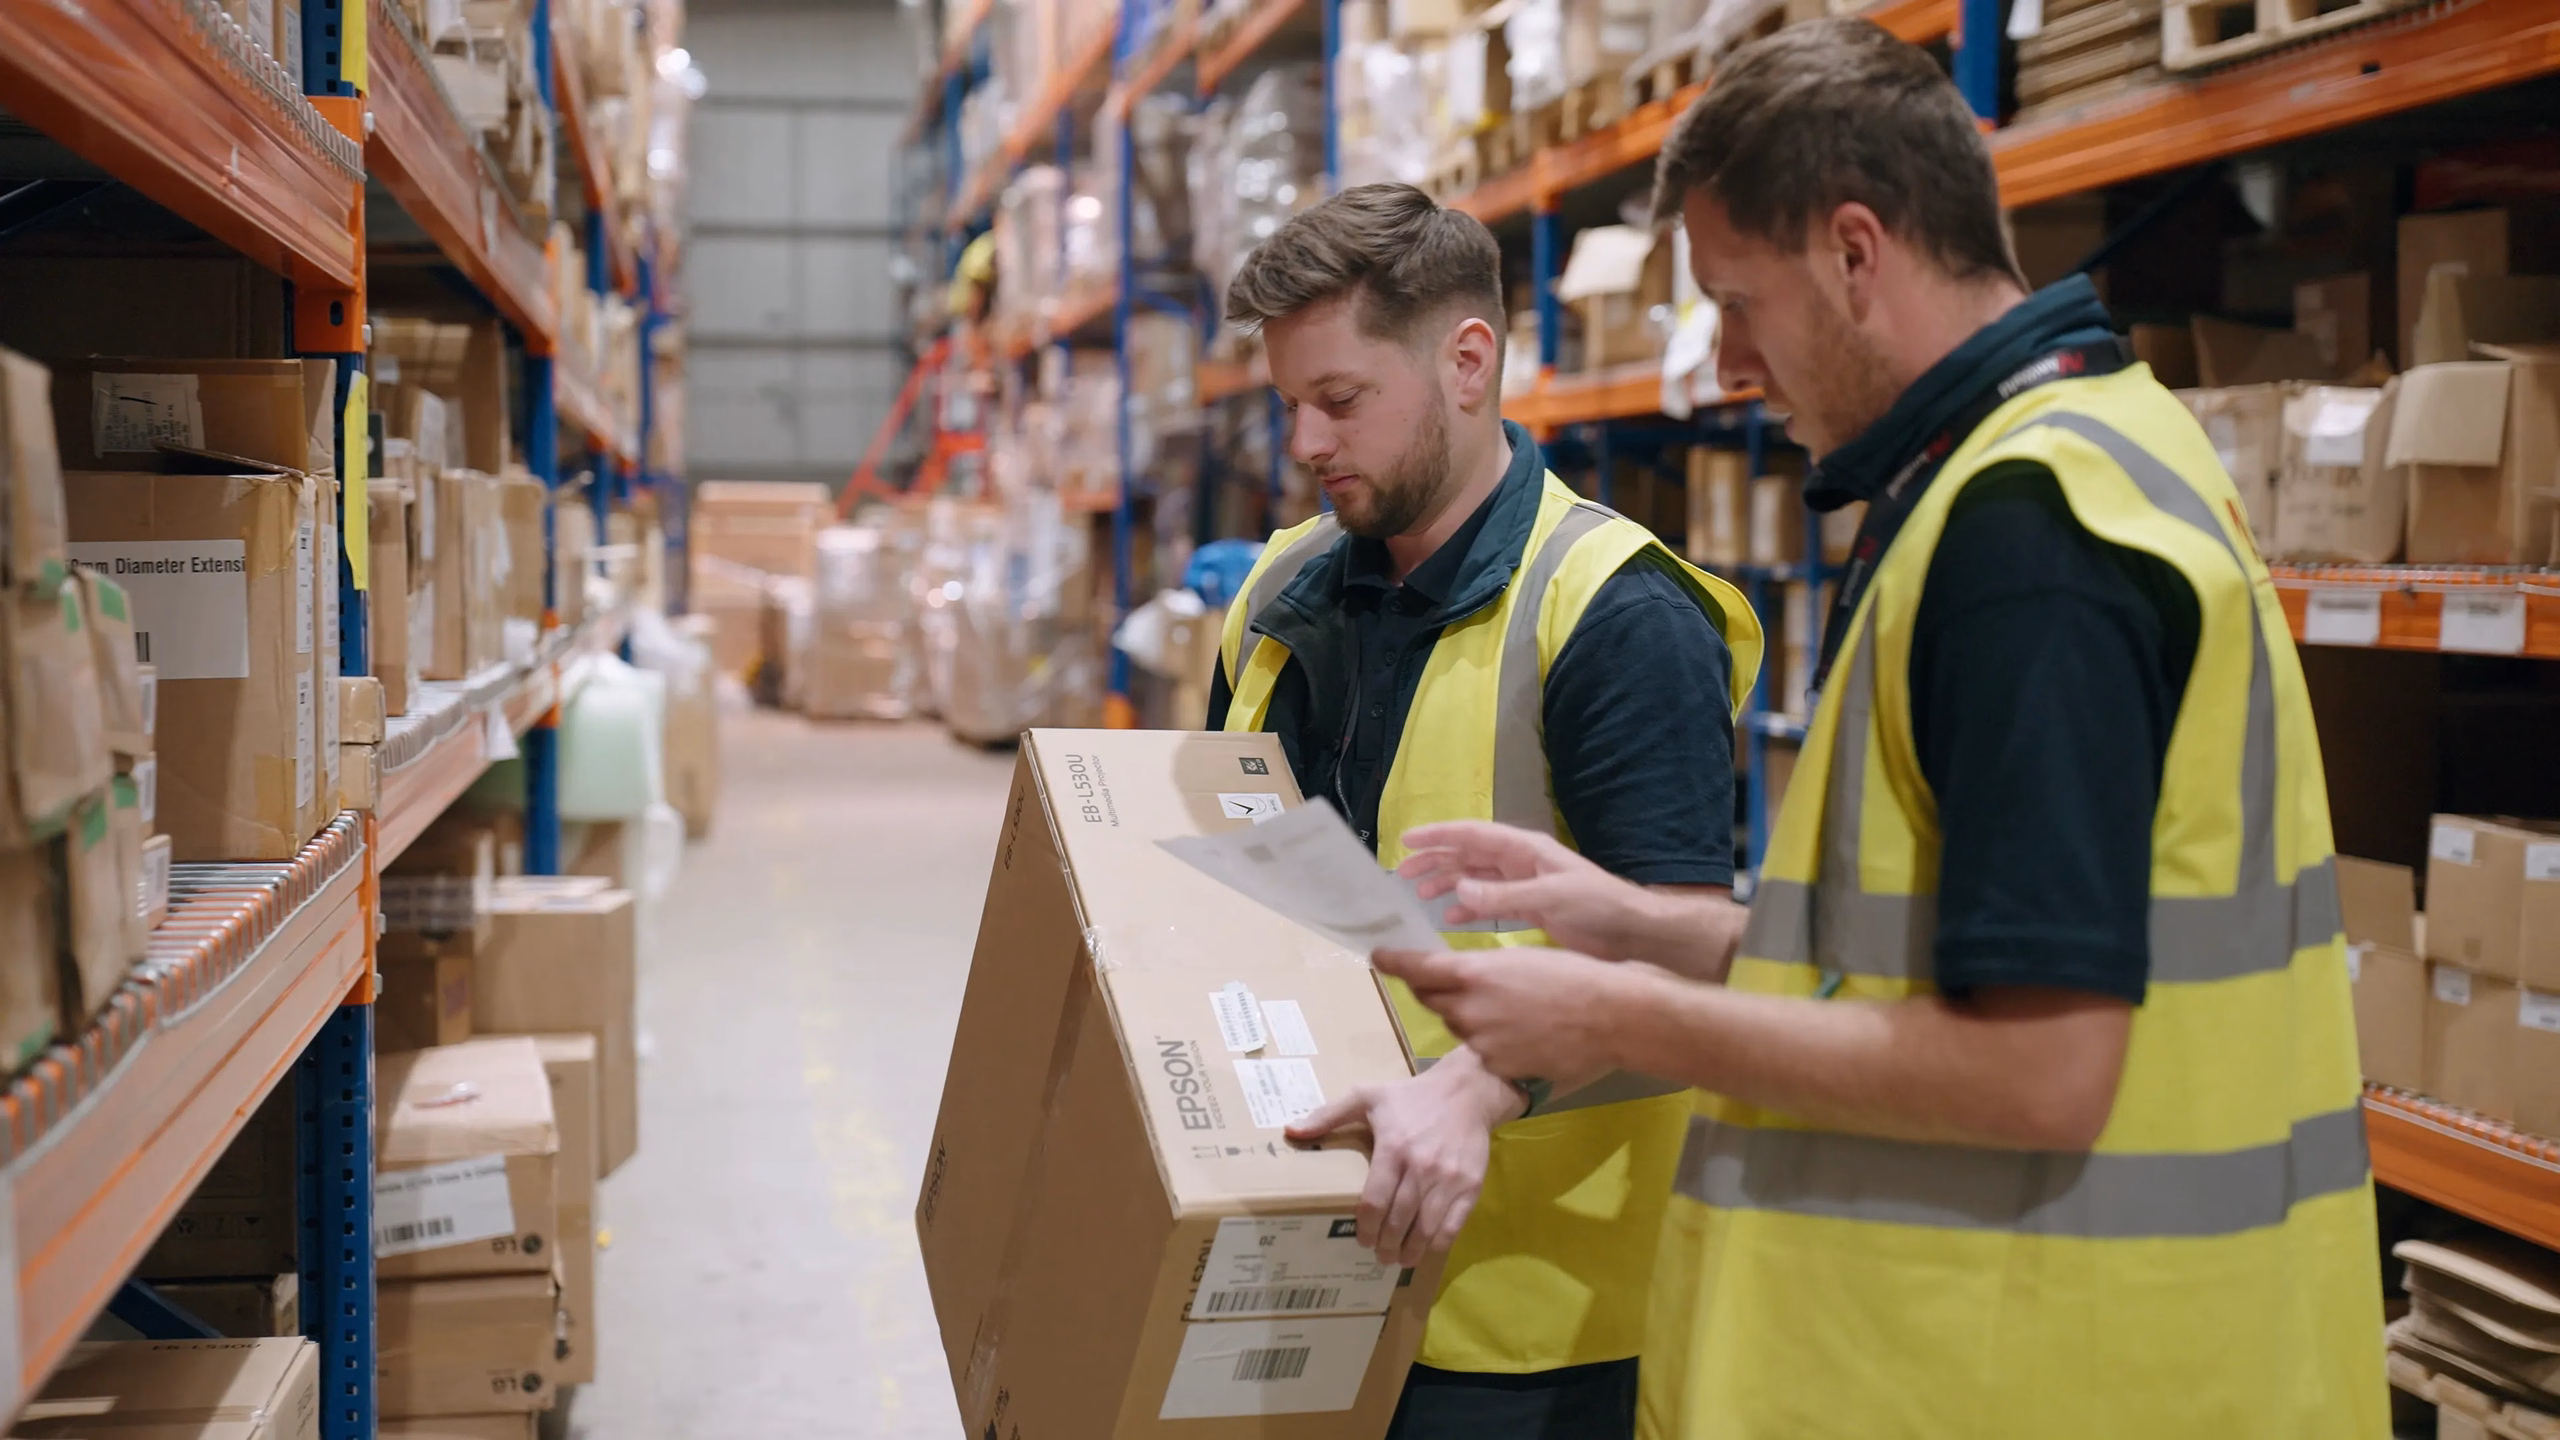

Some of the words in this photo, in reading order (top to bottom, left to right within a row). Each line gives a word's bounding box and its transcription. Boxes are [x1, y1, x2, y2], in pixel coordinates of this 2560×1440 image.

[115, 557, 185, 574] Diameter
[1091, 754, 1106, 786] Projector
[1065, 754, 1102, 823] EB-L530U
[1102, 788, 1120, 827] Multimedia
[1359, 829, 1370, 844] rld
[1190, 1040, 1205, 1068] VISION
[1156, 1040, 1212, 1130] EPSON
[1198, 1070, 1212, 1092] YOUR
[1207, 1095, 1225, 1130] EXCEED
[924, 1135, 947, 1221] EPSON
